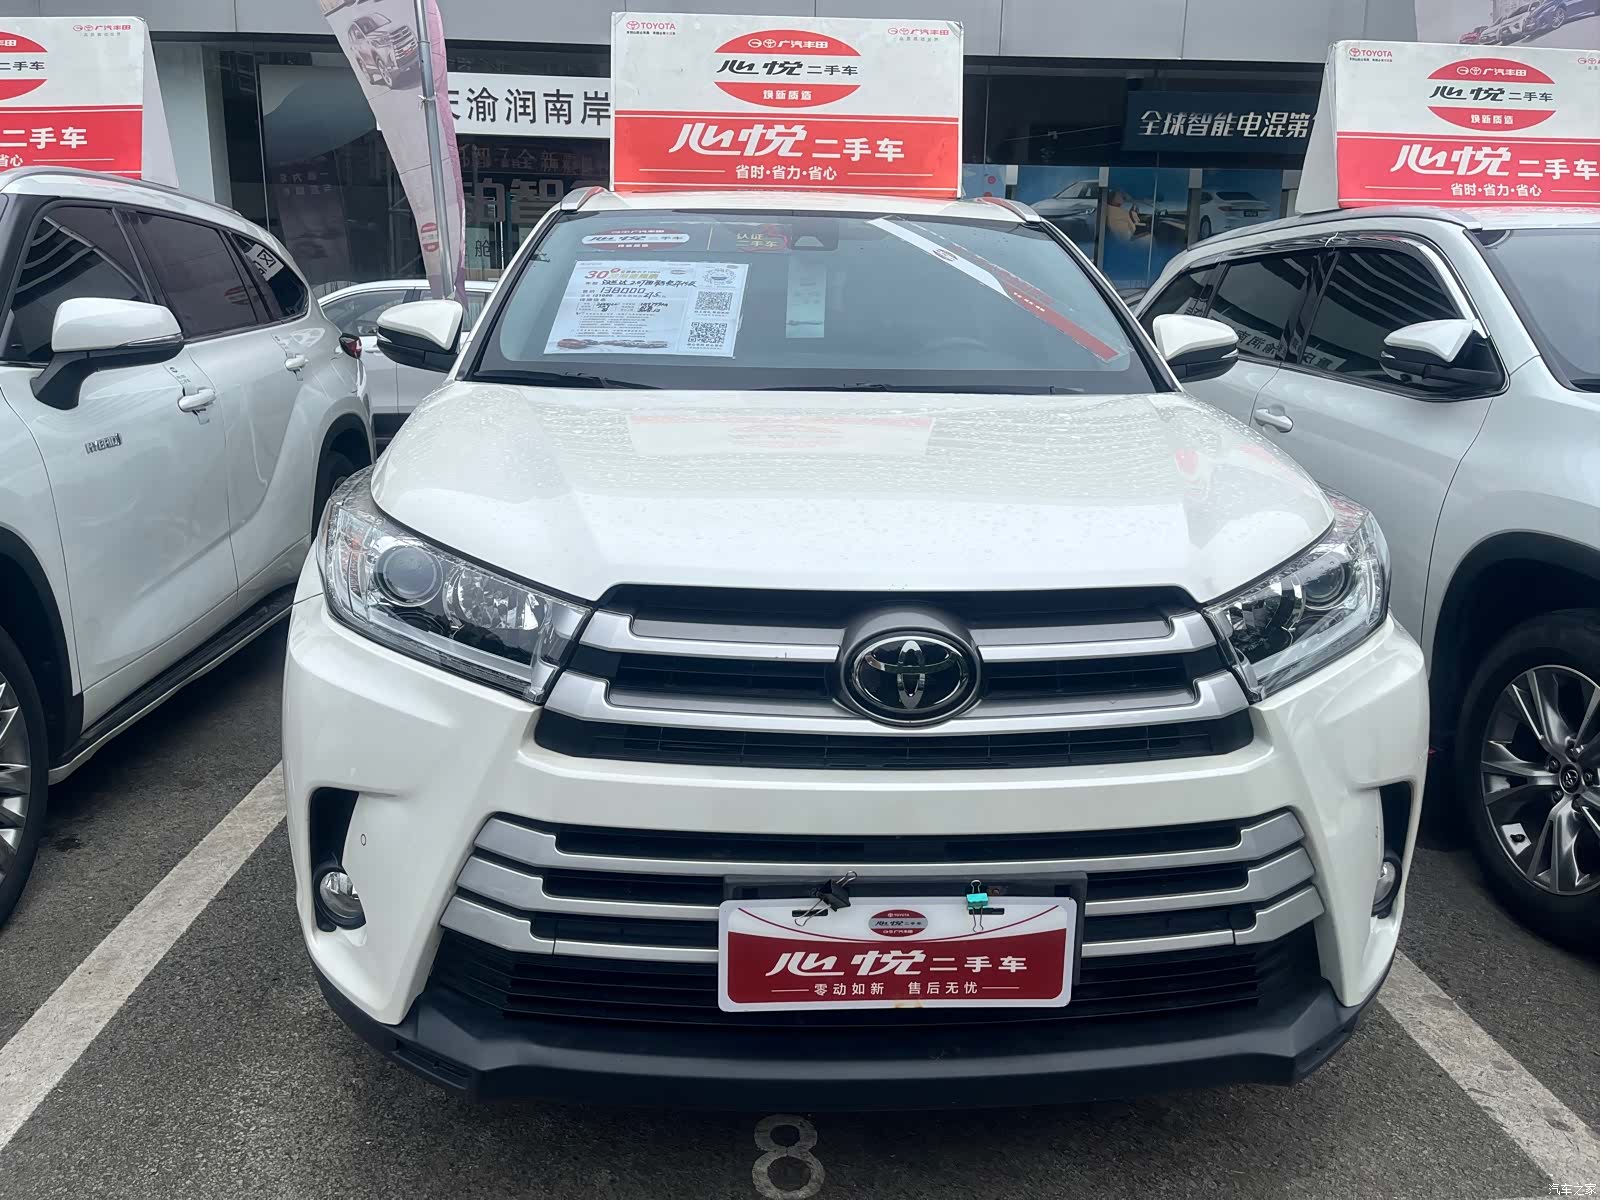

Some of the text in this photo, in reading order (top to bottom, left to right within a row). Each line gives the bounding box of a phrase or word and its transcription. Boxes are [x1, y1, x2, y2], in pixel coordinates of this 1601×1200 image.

[641, 22, 676, 30] TOYOTA
[777, 39, 829, 49] 广汽丰田
[1361, 49, 1393, 58] TOYOTA
[716, 59, 859, 76] 心悦二手车
[1482, 68, 1527, 77] 广汽丰田
[1429, 85, 1554, 102] 心悦二手车
[1137, 110, 1311, 138] 全球智能电混第
[668, 122, 905, 162] 心悦二手车
[1390, 143, 1600, 181] 心悦二手车
[765, 949, 1028, 977] 心悦二手车
[814, 980, 978, 997] 零动如新 售后无忧
[751, 1113, 826, 1200] 8
